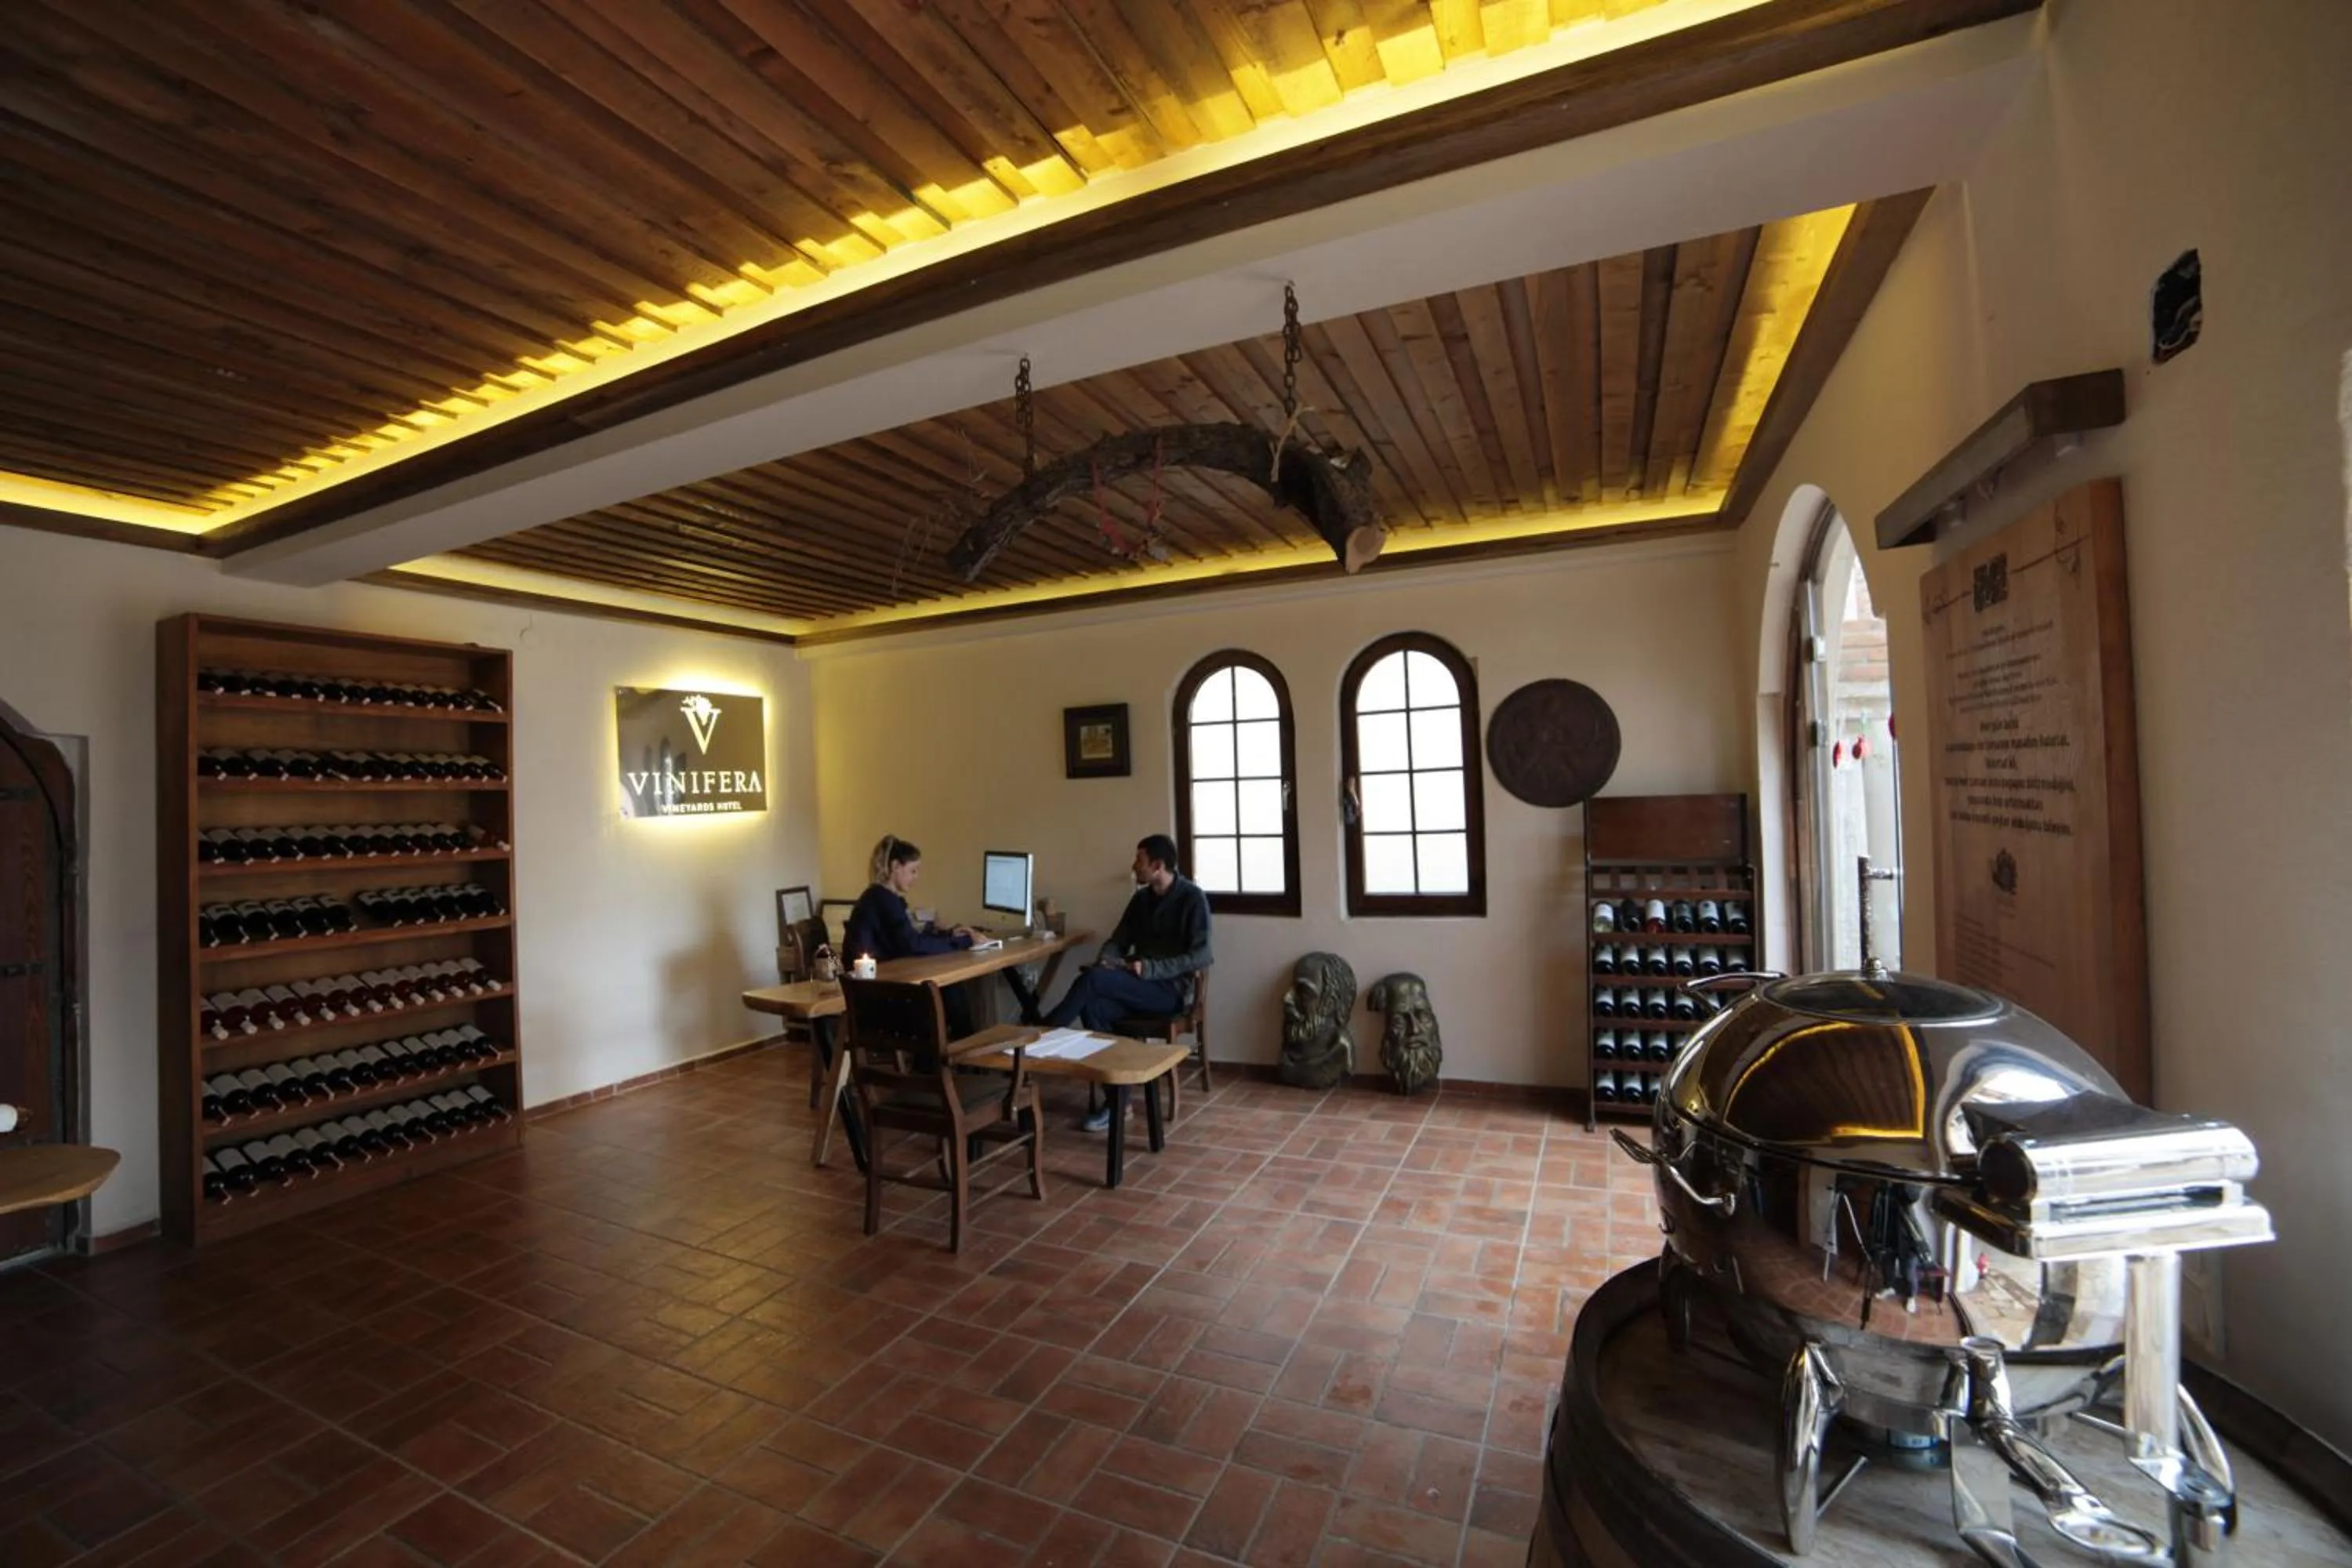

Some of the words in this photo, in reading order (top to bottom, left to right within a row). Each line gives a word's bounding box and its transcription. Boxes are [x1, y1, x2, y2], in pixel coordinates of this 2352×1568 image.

[681, 707, 720, 754] V
[628, 771, 762, 795] VINIFERA
[662, 803, 714, 813] VINEYARDS
[717, 801, 742, 810] HOTEL
